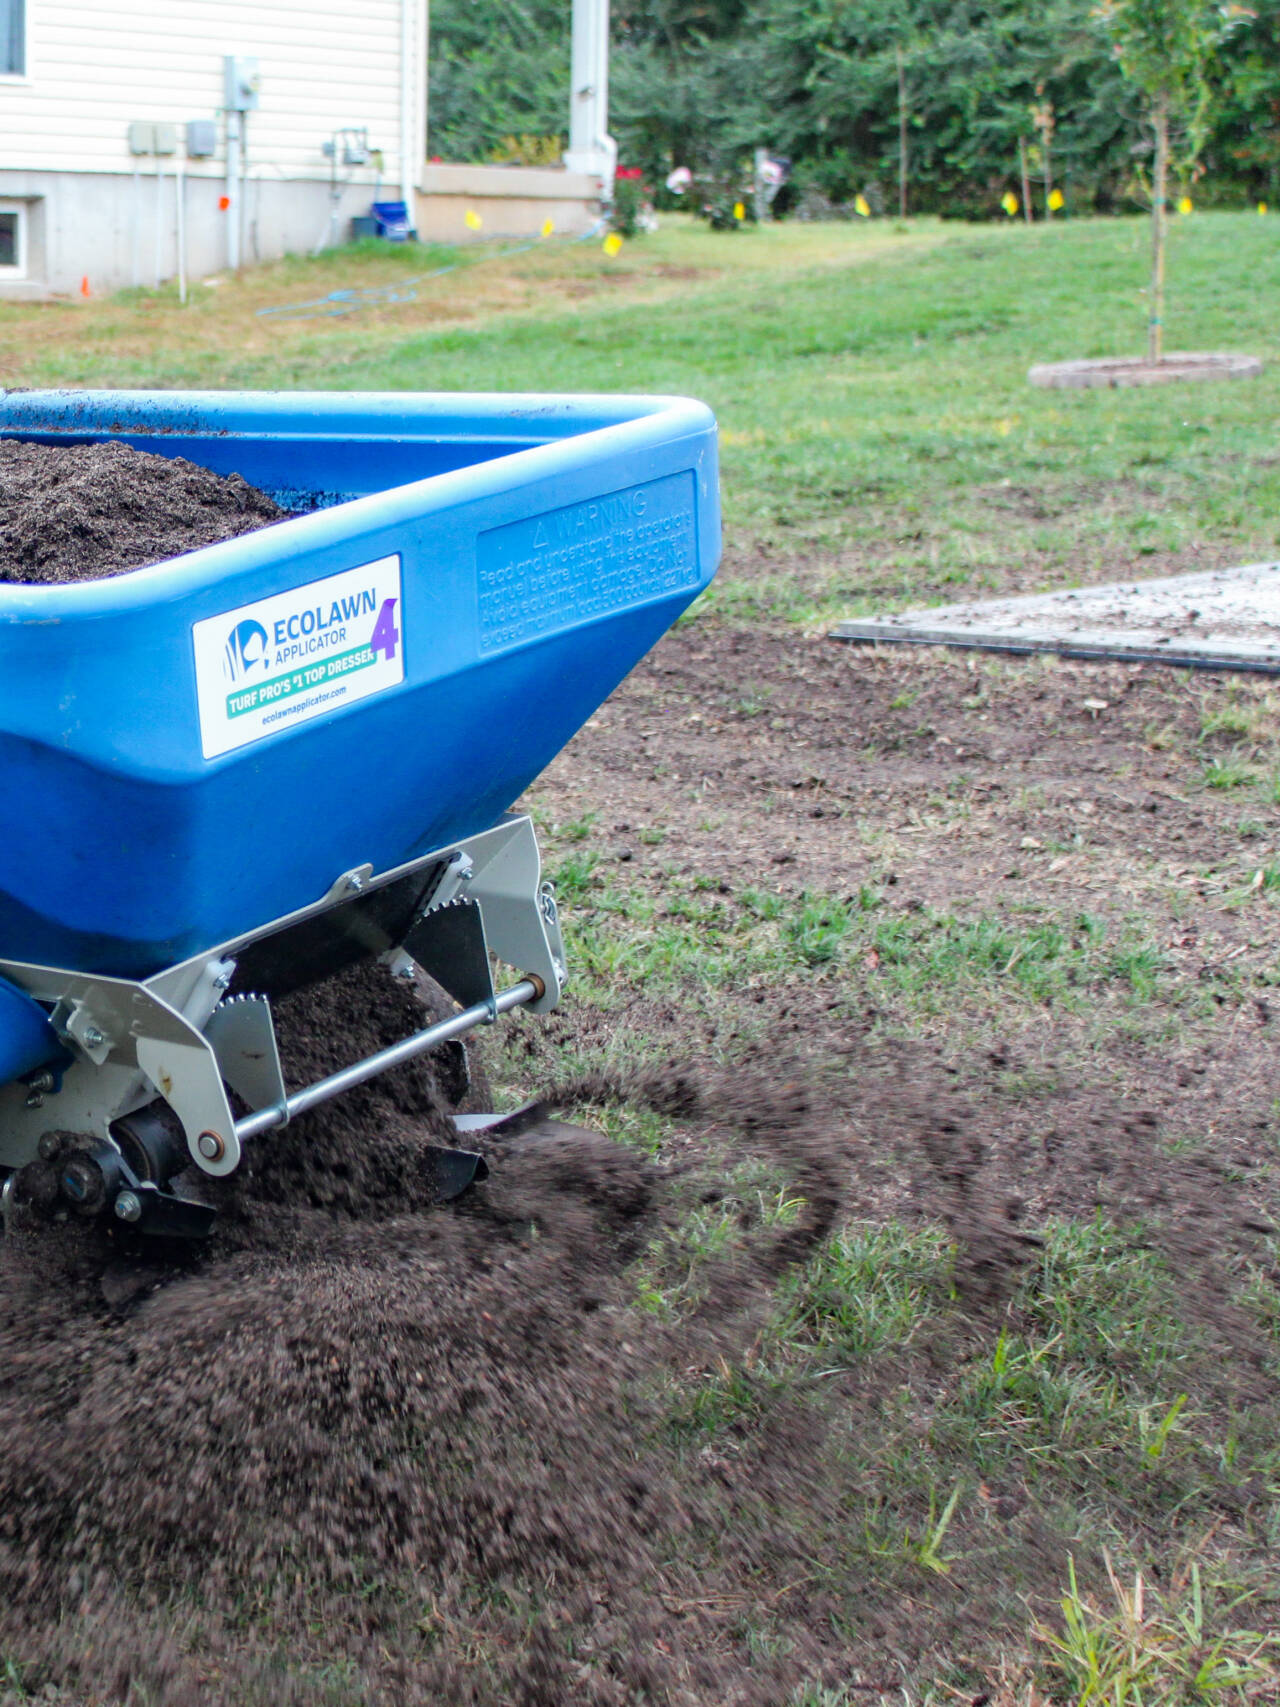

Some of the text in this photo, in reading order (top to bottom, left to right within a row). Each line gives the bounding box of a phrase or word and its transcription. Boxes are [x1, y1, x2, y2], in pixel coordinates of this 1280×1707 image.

[555, 490, 647, 538] WARNING
[272, 587, 377, 646] ECOLAWN
[369, 598, 399, 661] 4
[274, 627, 347, 666] APPLICATOR
[228, 648, 375, 714] TURF PRO'S #1 TOP DRESSER
[261, 684, 347, 726] ecolawnapplicator.com
